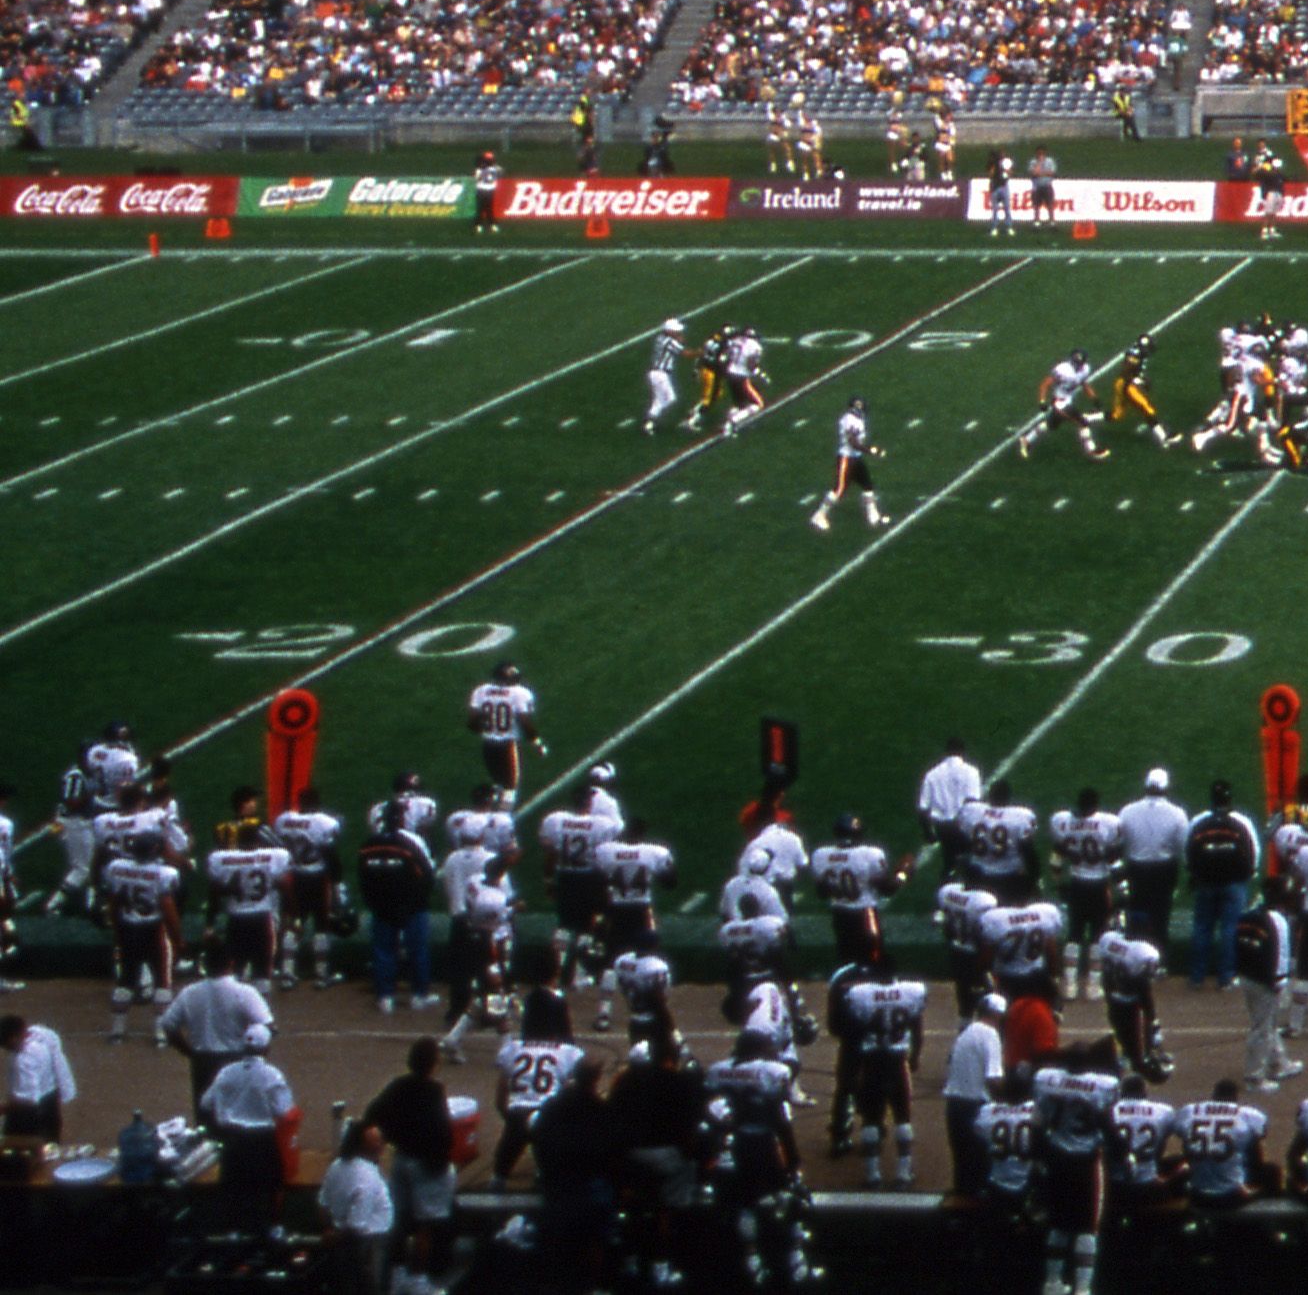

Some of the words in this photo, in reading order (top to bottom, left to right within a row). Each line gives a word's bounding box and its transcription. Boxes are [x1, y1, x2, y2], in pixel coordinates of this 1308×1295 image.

[349, 177, 465, 203] Gatorade
[505, 180, 710, 217] Budweiser
[763, 188, 841, 209] Ireland
[1101, 190, 1196, 213] Wilson
[214, 622, 516, 659] 20
[980, 631, 1254, 666] 30
[514, 1054, 557, 1093] 26
[1190, 1119, 1235, 1159] 55
